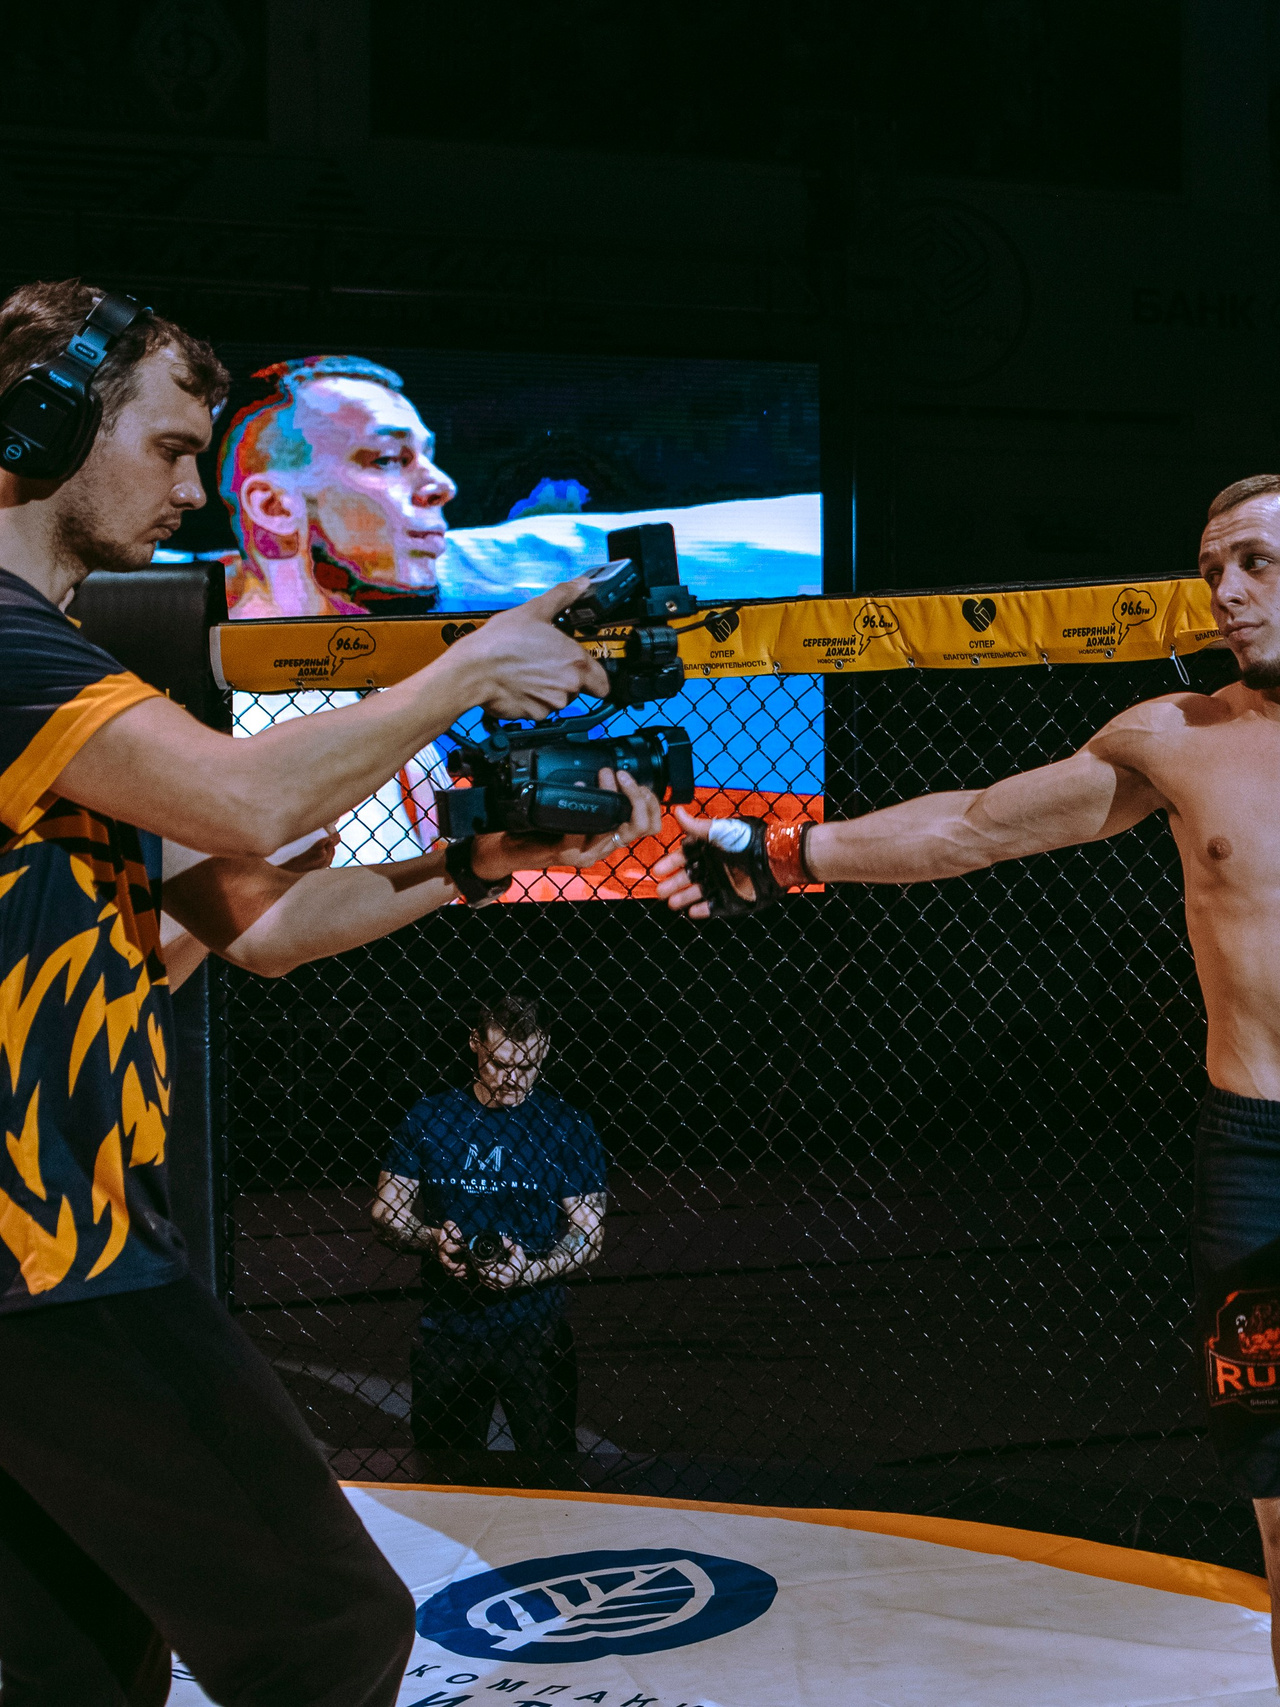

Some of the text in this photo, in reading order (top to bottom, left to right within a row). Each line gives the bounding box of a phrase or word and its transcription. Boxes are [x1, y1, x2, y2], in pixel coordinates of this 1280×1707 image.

[1132, 286, 1257, 332] БАНК
[1062, 623, 1116, 638] СЕРЕБРЯНЫЙ
[1195, 630, 1222, 641] БЛАГОТ
[802, 635, 856, 648] СЕРЕБРЯНЫЙ
[969, 639, 996, 649] СУПЕР
[1086, 637, 1116, 647] ДОЖДЬ
[710, 650, 735, 658] СУПЕР
[825, 646, 856, 657] ДОЖДЬ
[273, 656, 330, 668] СЕРЕБРЯНЫЙ
[297, 667, 329, 677] ДОЖДЬ
[558, 800, 599, 813] SONY
